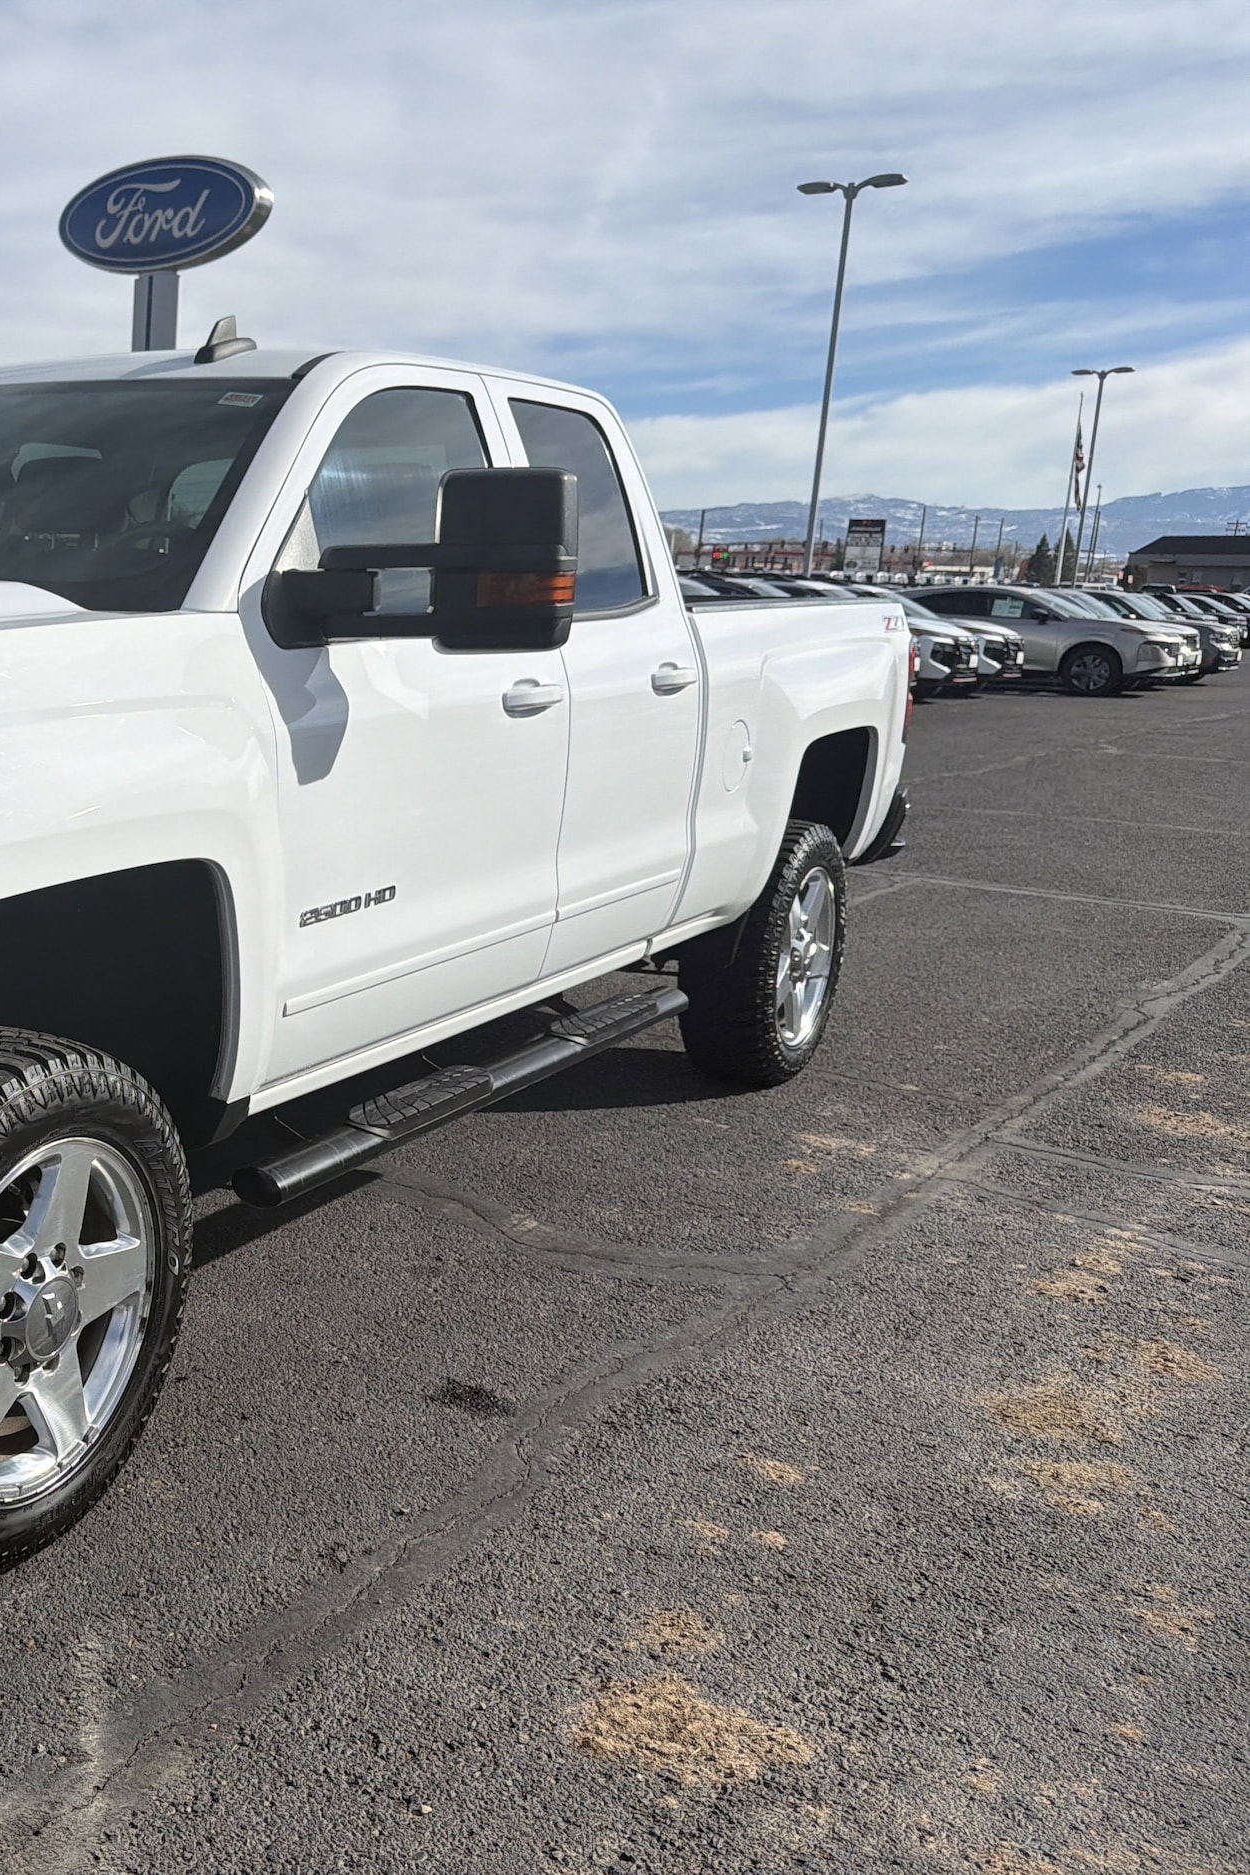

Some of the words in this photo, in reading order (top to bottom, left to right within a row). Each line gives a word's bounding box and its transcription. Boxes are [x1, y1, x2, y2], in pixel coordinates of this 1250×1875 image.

[95, 178, 211, 249] Ford
[299, 895, 362, 928] 2500
[364, 884, 396, 909] HD
[133, 1139, 180, 1276] ATTURO
